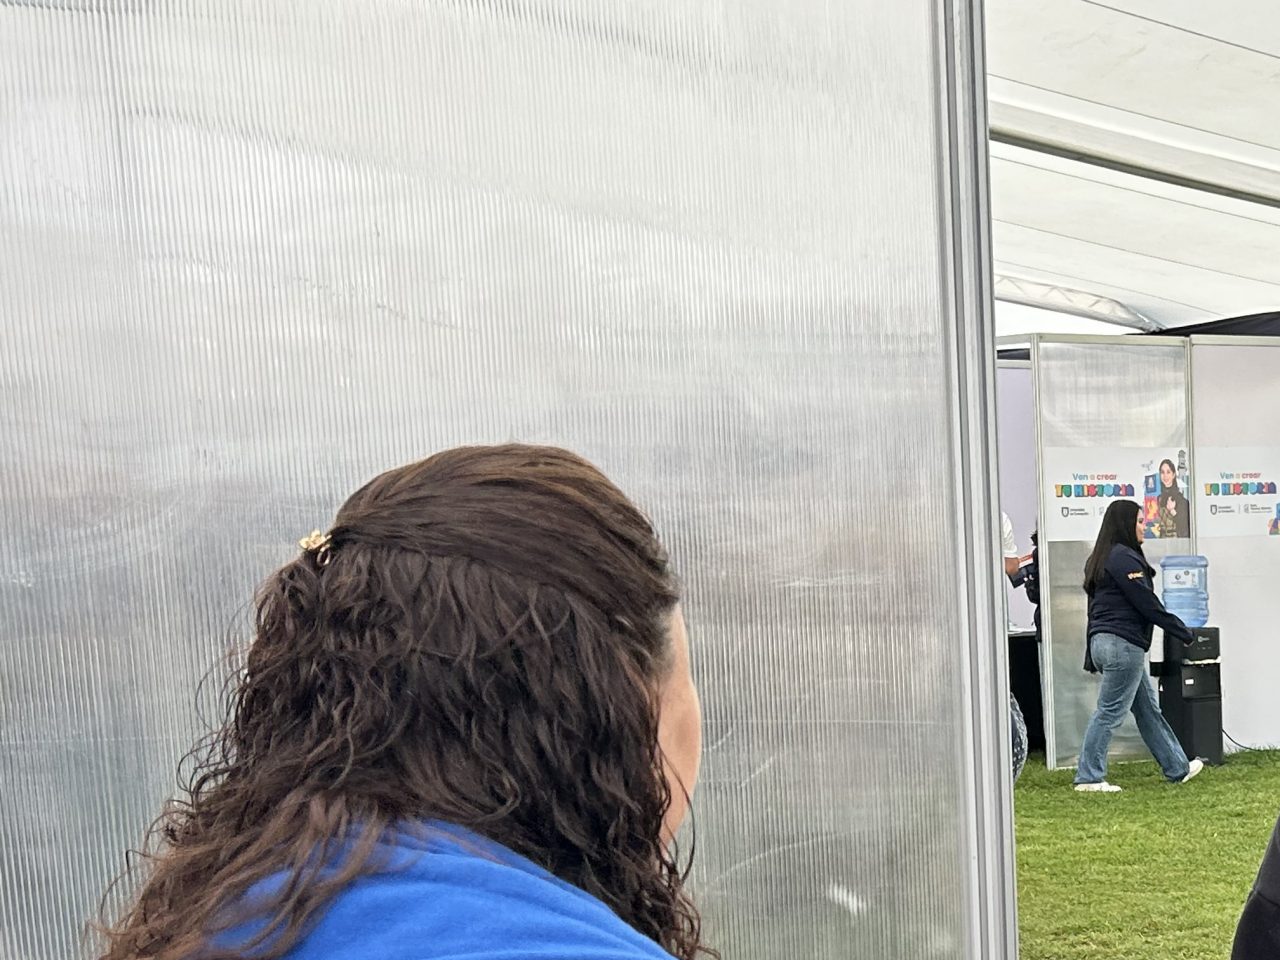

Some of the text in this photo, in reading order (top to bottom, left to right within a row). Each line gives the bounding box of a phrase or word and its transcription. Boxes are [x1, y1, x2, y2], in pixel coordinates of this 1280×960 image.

[1072, 473, 1088, 481] Ven
[1096, 473, 1117, 481] crear
[1220, 471, 1234, 480] Ven
